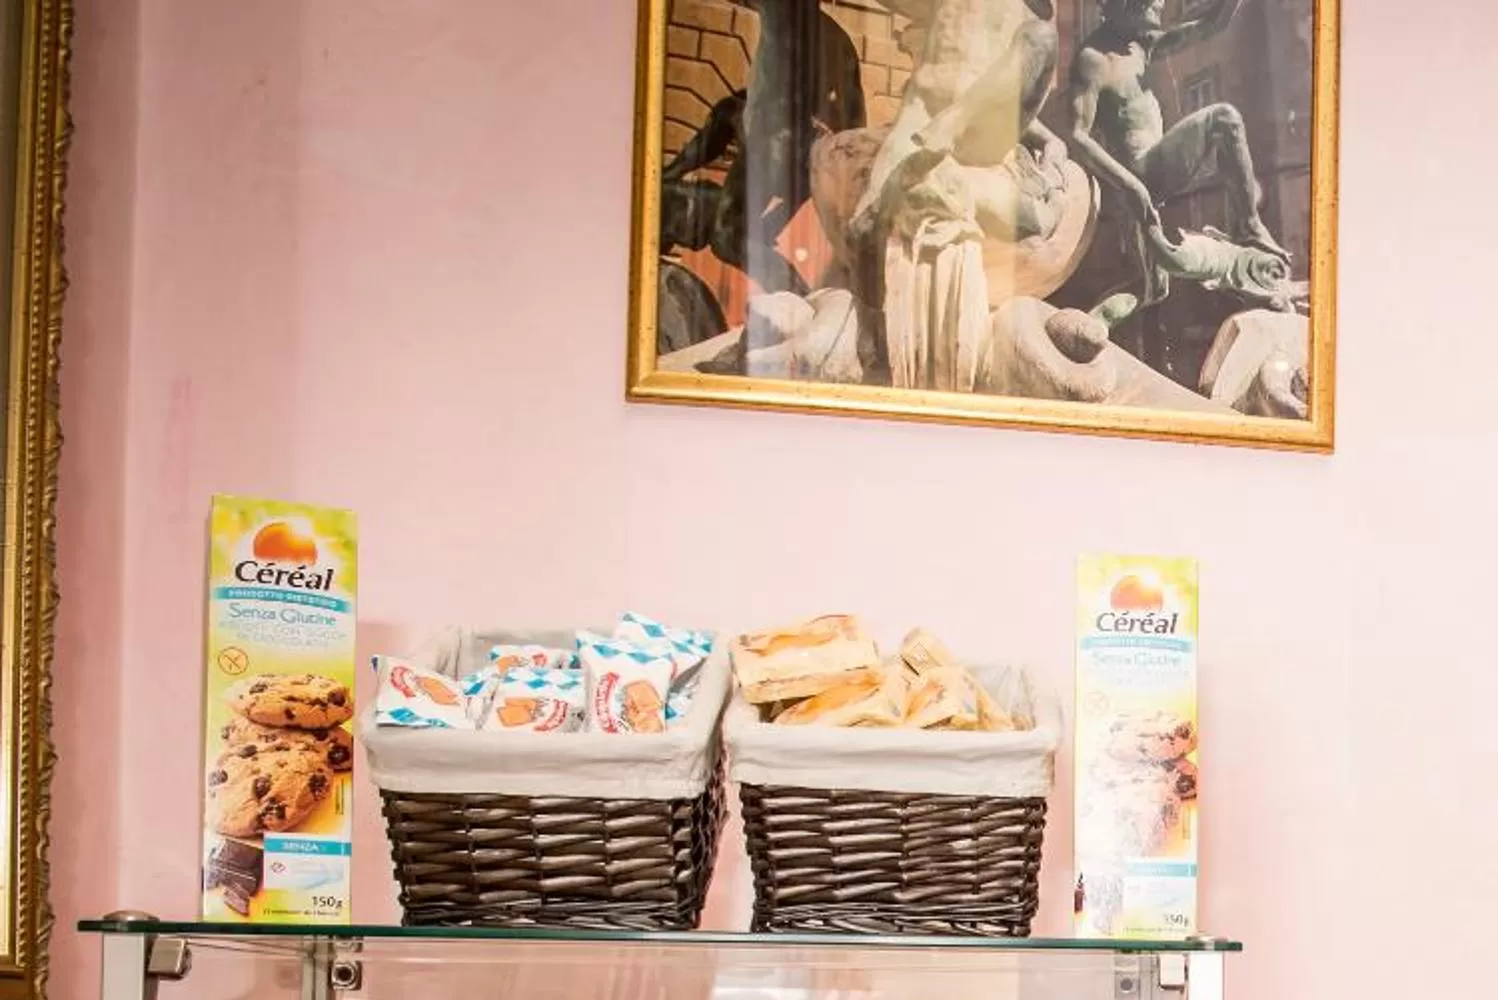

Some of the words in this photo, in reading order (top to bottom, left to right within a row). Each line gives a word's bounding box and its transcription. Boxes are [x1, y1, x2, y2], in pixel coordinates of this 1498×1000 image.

[234, 560, 334, 591] Céréal
[229, 602, 277, 620] Senza
[279, 608, 337, 626] Glutine
[1096, 611, 1179, 635] Céréal
[311, 895, 343, 909] 150g
